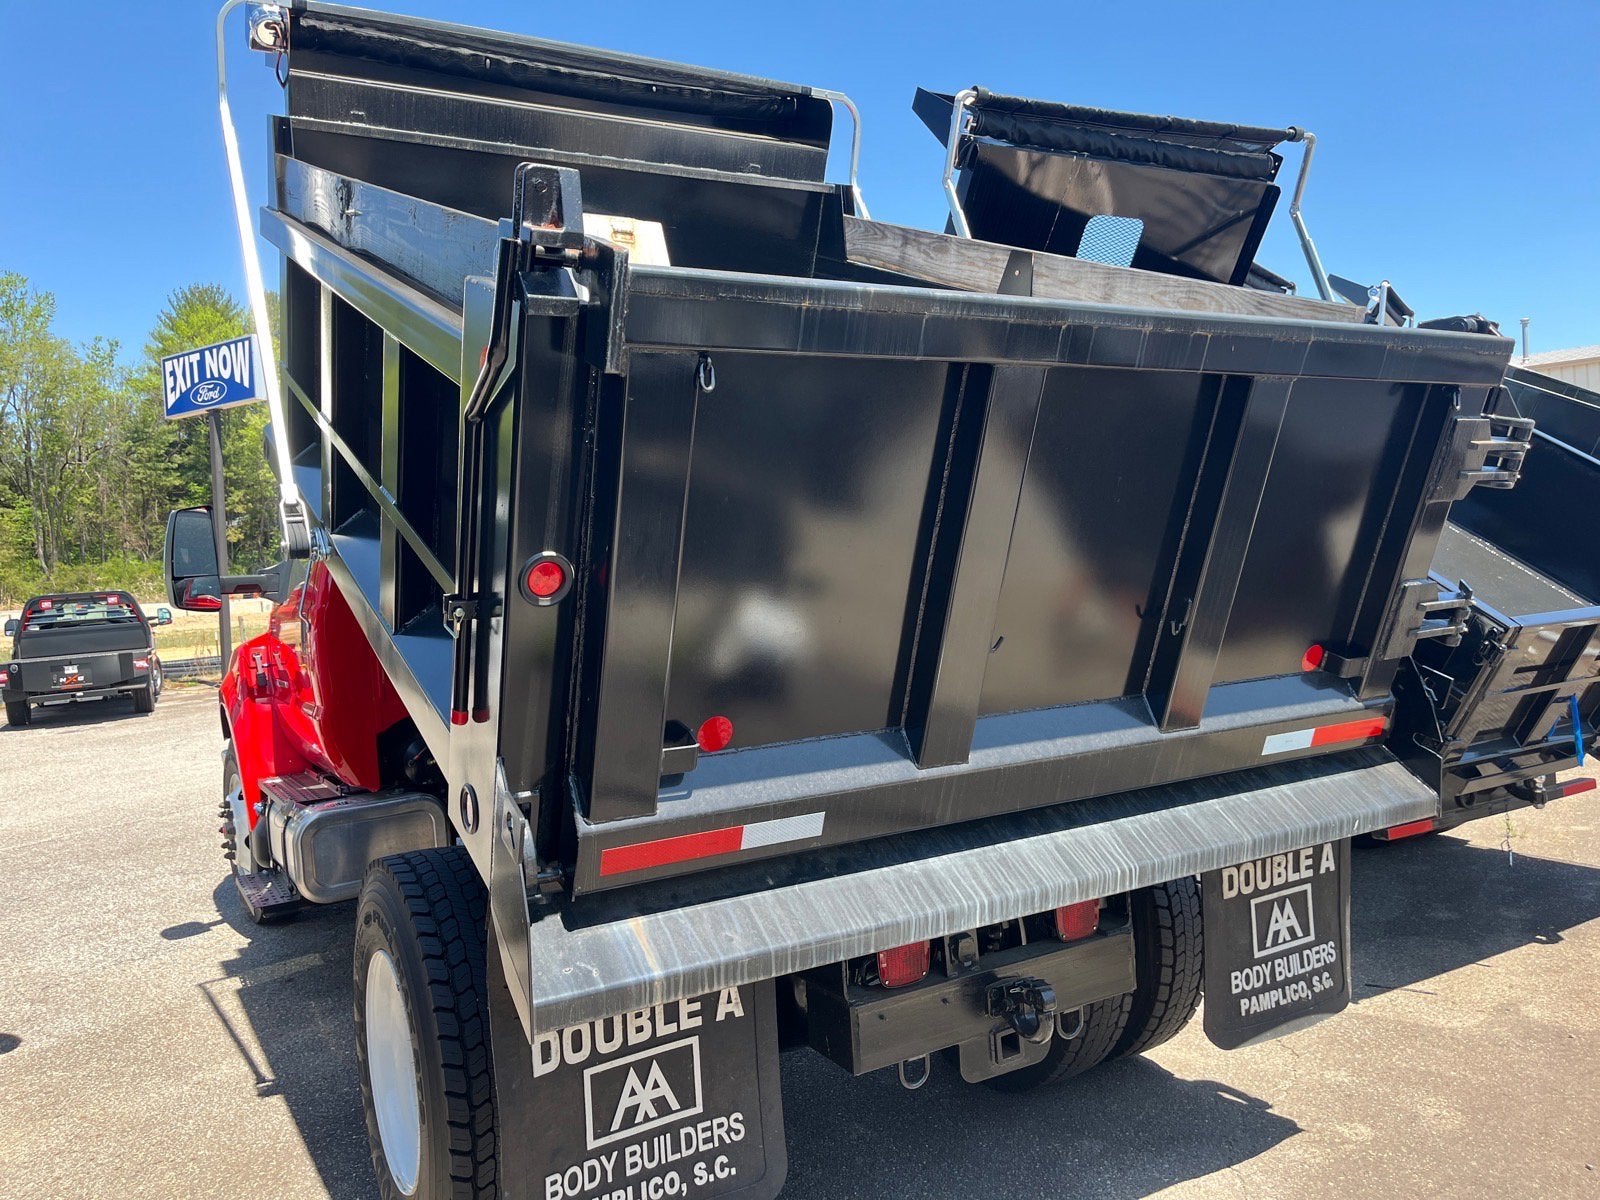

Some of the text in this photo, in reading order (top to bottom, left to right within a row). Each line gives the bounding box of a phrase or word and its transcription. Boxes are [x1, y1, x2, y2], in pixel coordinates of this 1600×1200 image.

[165, 340, 249, 409] EXIT NOW
[197, 384, 220, 403] Ford
[1222, 843, 1336, 900] DOUBLE A
[1231, 941, 1337, 994] BODY BUILDERS
[1240, 972, 1334, 1016] PAMPLICO, S.C.
[532, 986, 745, 1078] DOUBLE A
[545, 1112, 746, 1200] BODY BUILDERS
[694, 1155, 737, 1186] S.C.
